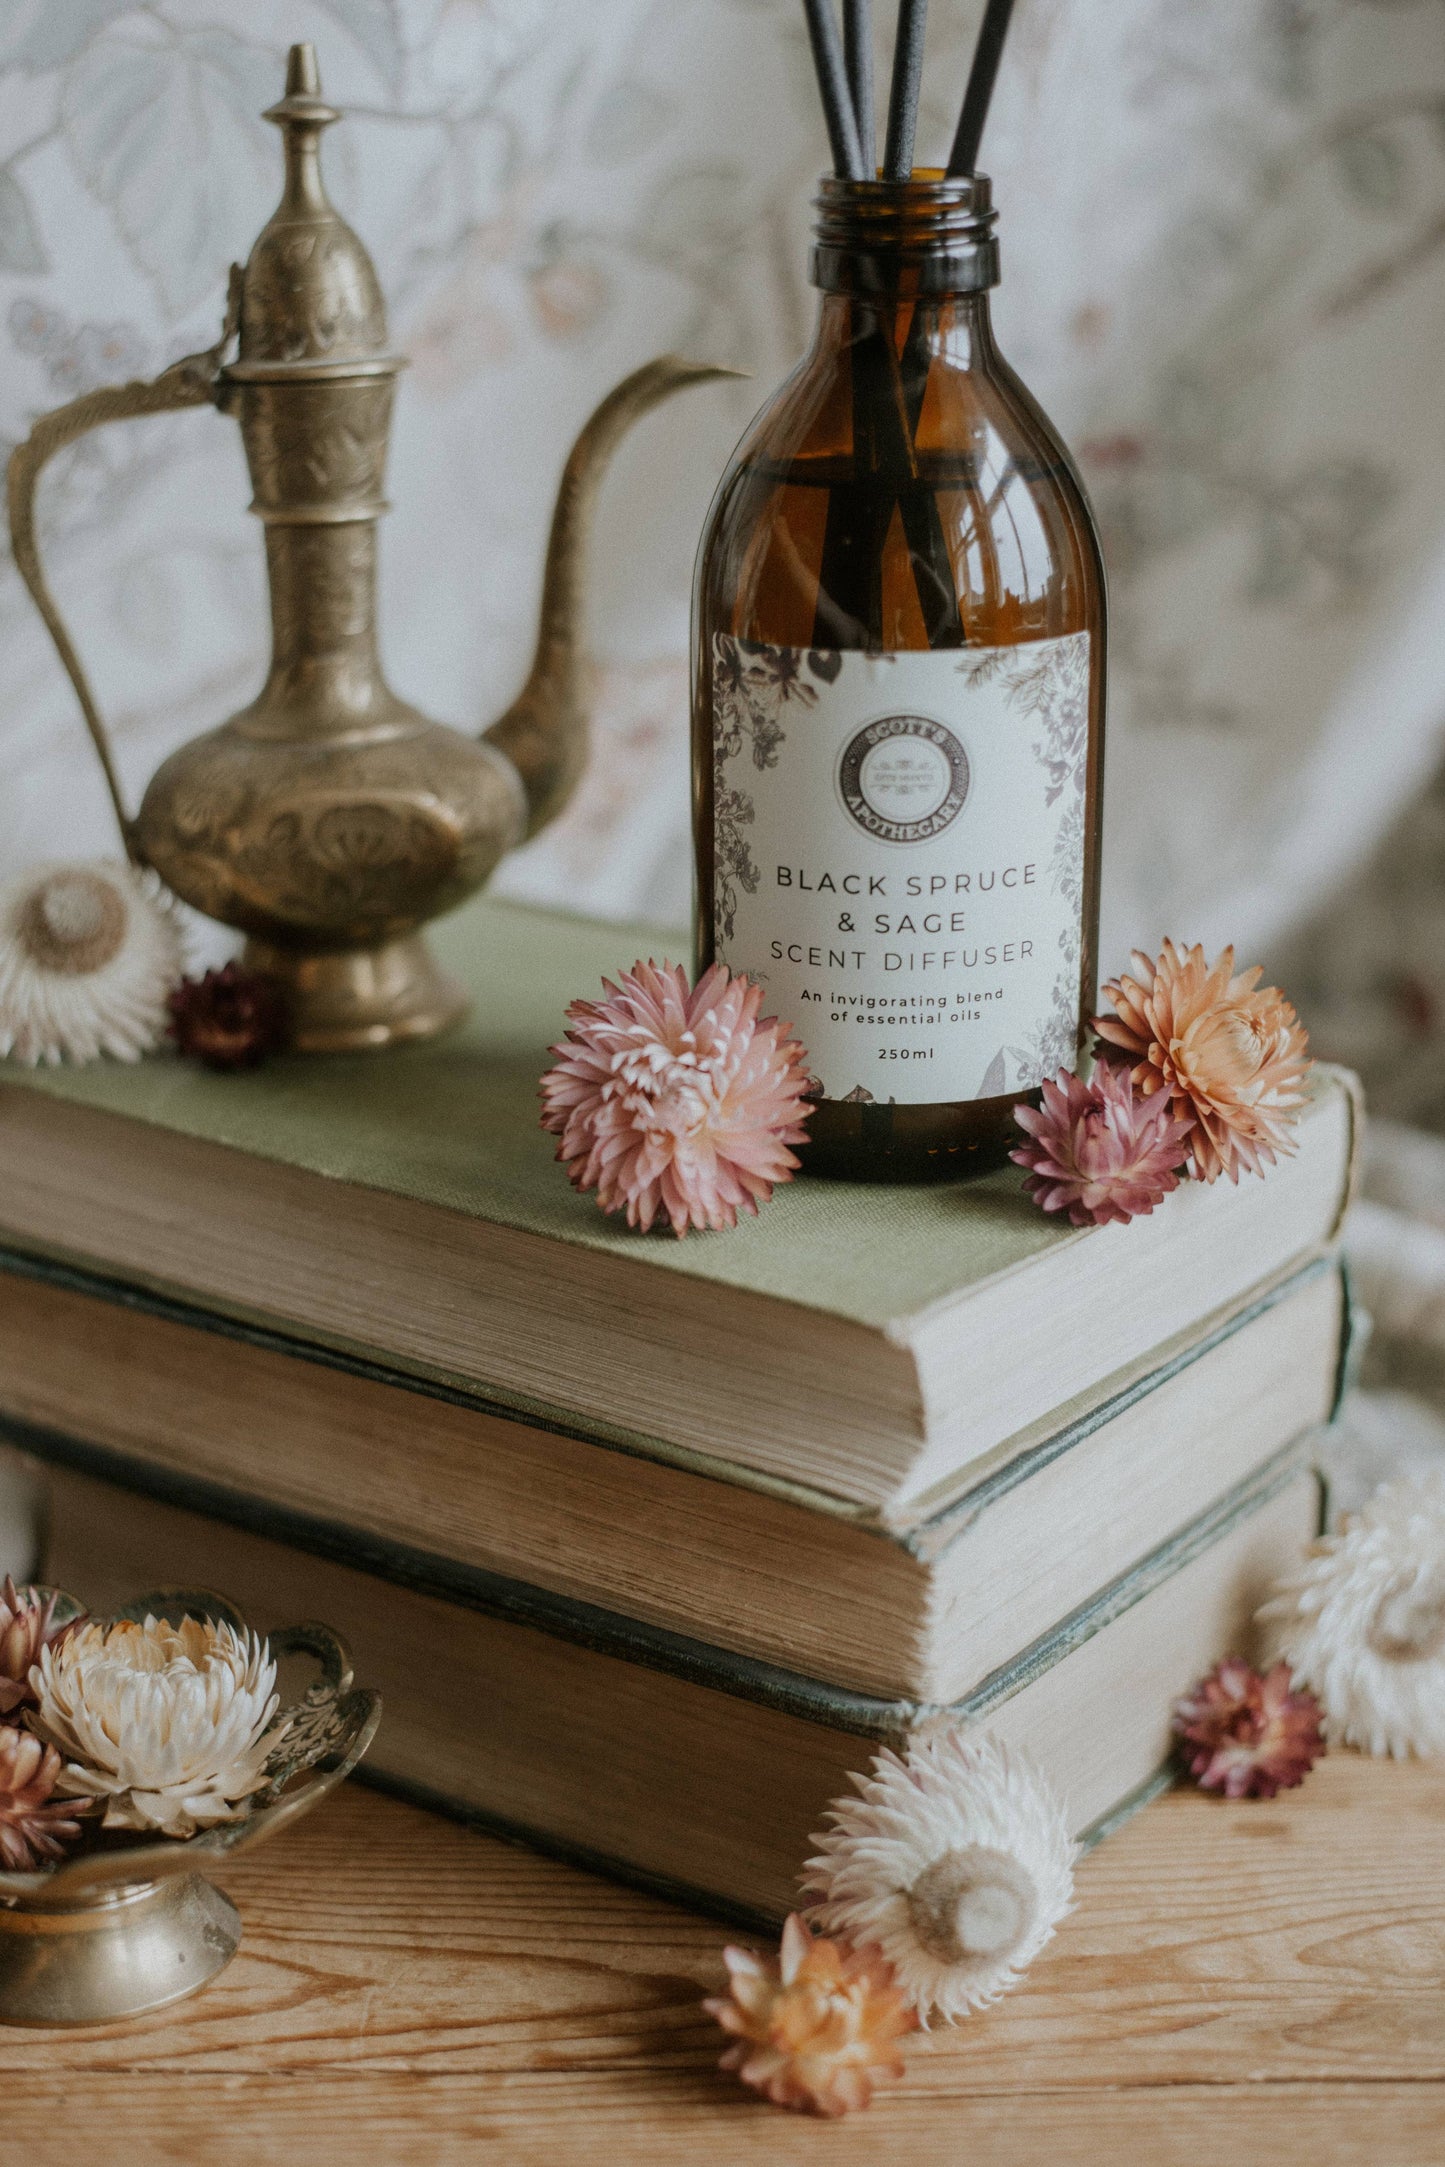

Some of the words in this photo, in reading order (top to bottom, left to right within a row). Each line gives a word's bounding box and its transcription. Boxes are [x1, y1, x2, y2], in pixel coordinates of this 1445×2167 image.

[847, 793, 962, 840] APOTHECARY
[777, 865, 886, 896] BLACK
[906, 864, 1036, 896] SPRUCE
[838, 912, 855, 932] &
[875, 912, 966, 934] SAGE
[770, 941, 866, 970] SCENT
[884, 940, 1034, 971] DIFFUSER
[801, 989, 822, 1002] An
[831, 992, 948, 1009] invigorating
[956, 988, 1003, 1004] blend
[831, 1011, 848, 1022] of
[856, 1011, 941, 1024] essential
[951, 1009, 981, 1022] oils
[878, 1048, 934, 1060] 250ml
